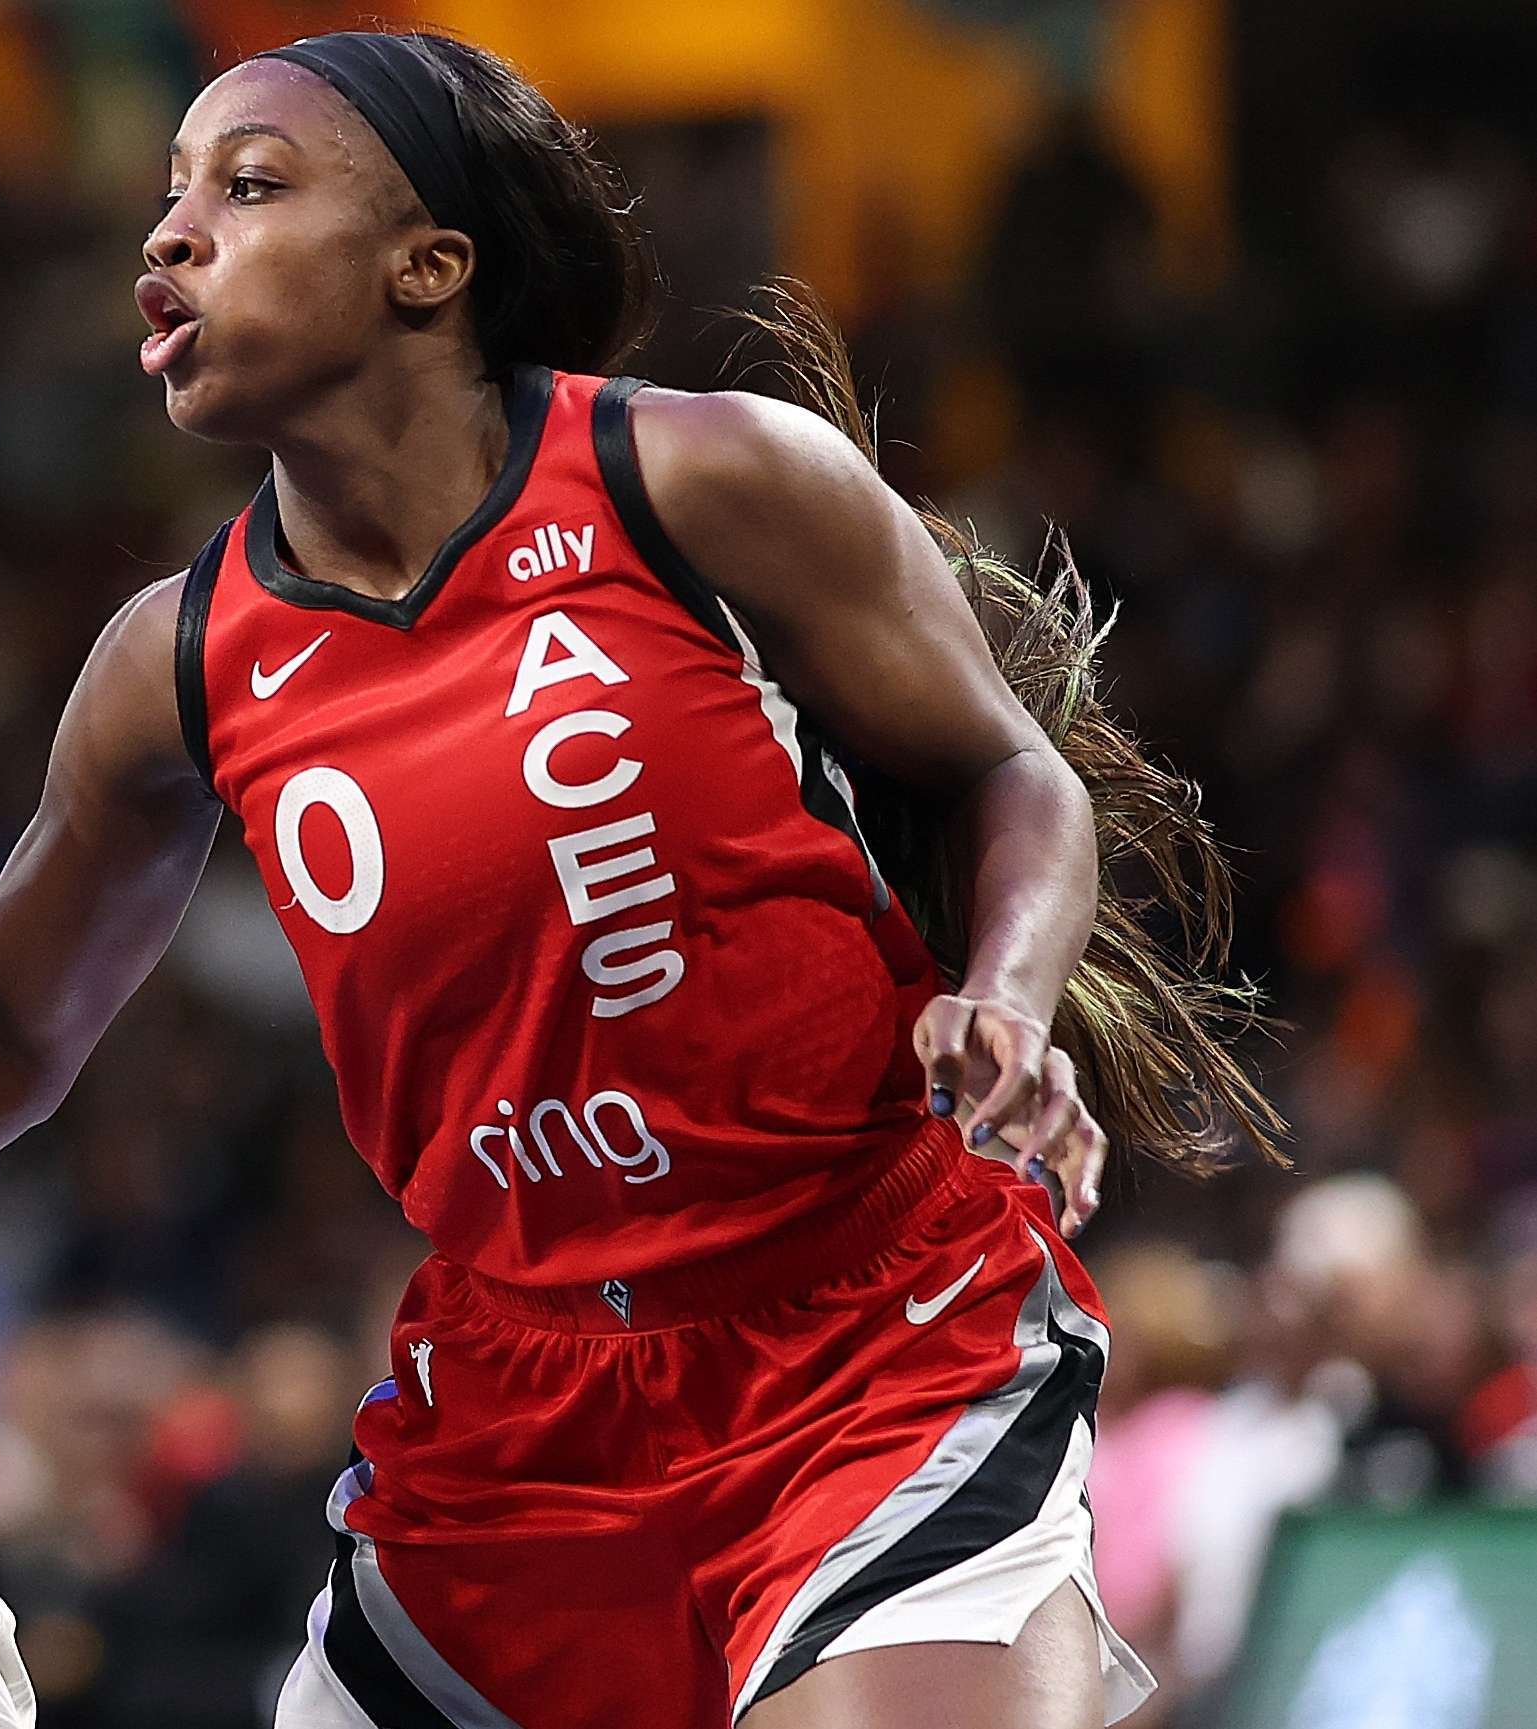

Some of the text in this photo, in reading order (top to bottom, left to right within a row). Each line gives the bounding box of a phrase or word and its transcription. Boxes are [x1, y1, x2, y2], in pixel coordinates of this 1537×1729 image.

[507, 522, 595, 582] ally
[275, 765, 386, 935] 0
[503, 610, 685, 1018] ACES
[469, 1090, 671, 1188] ring
